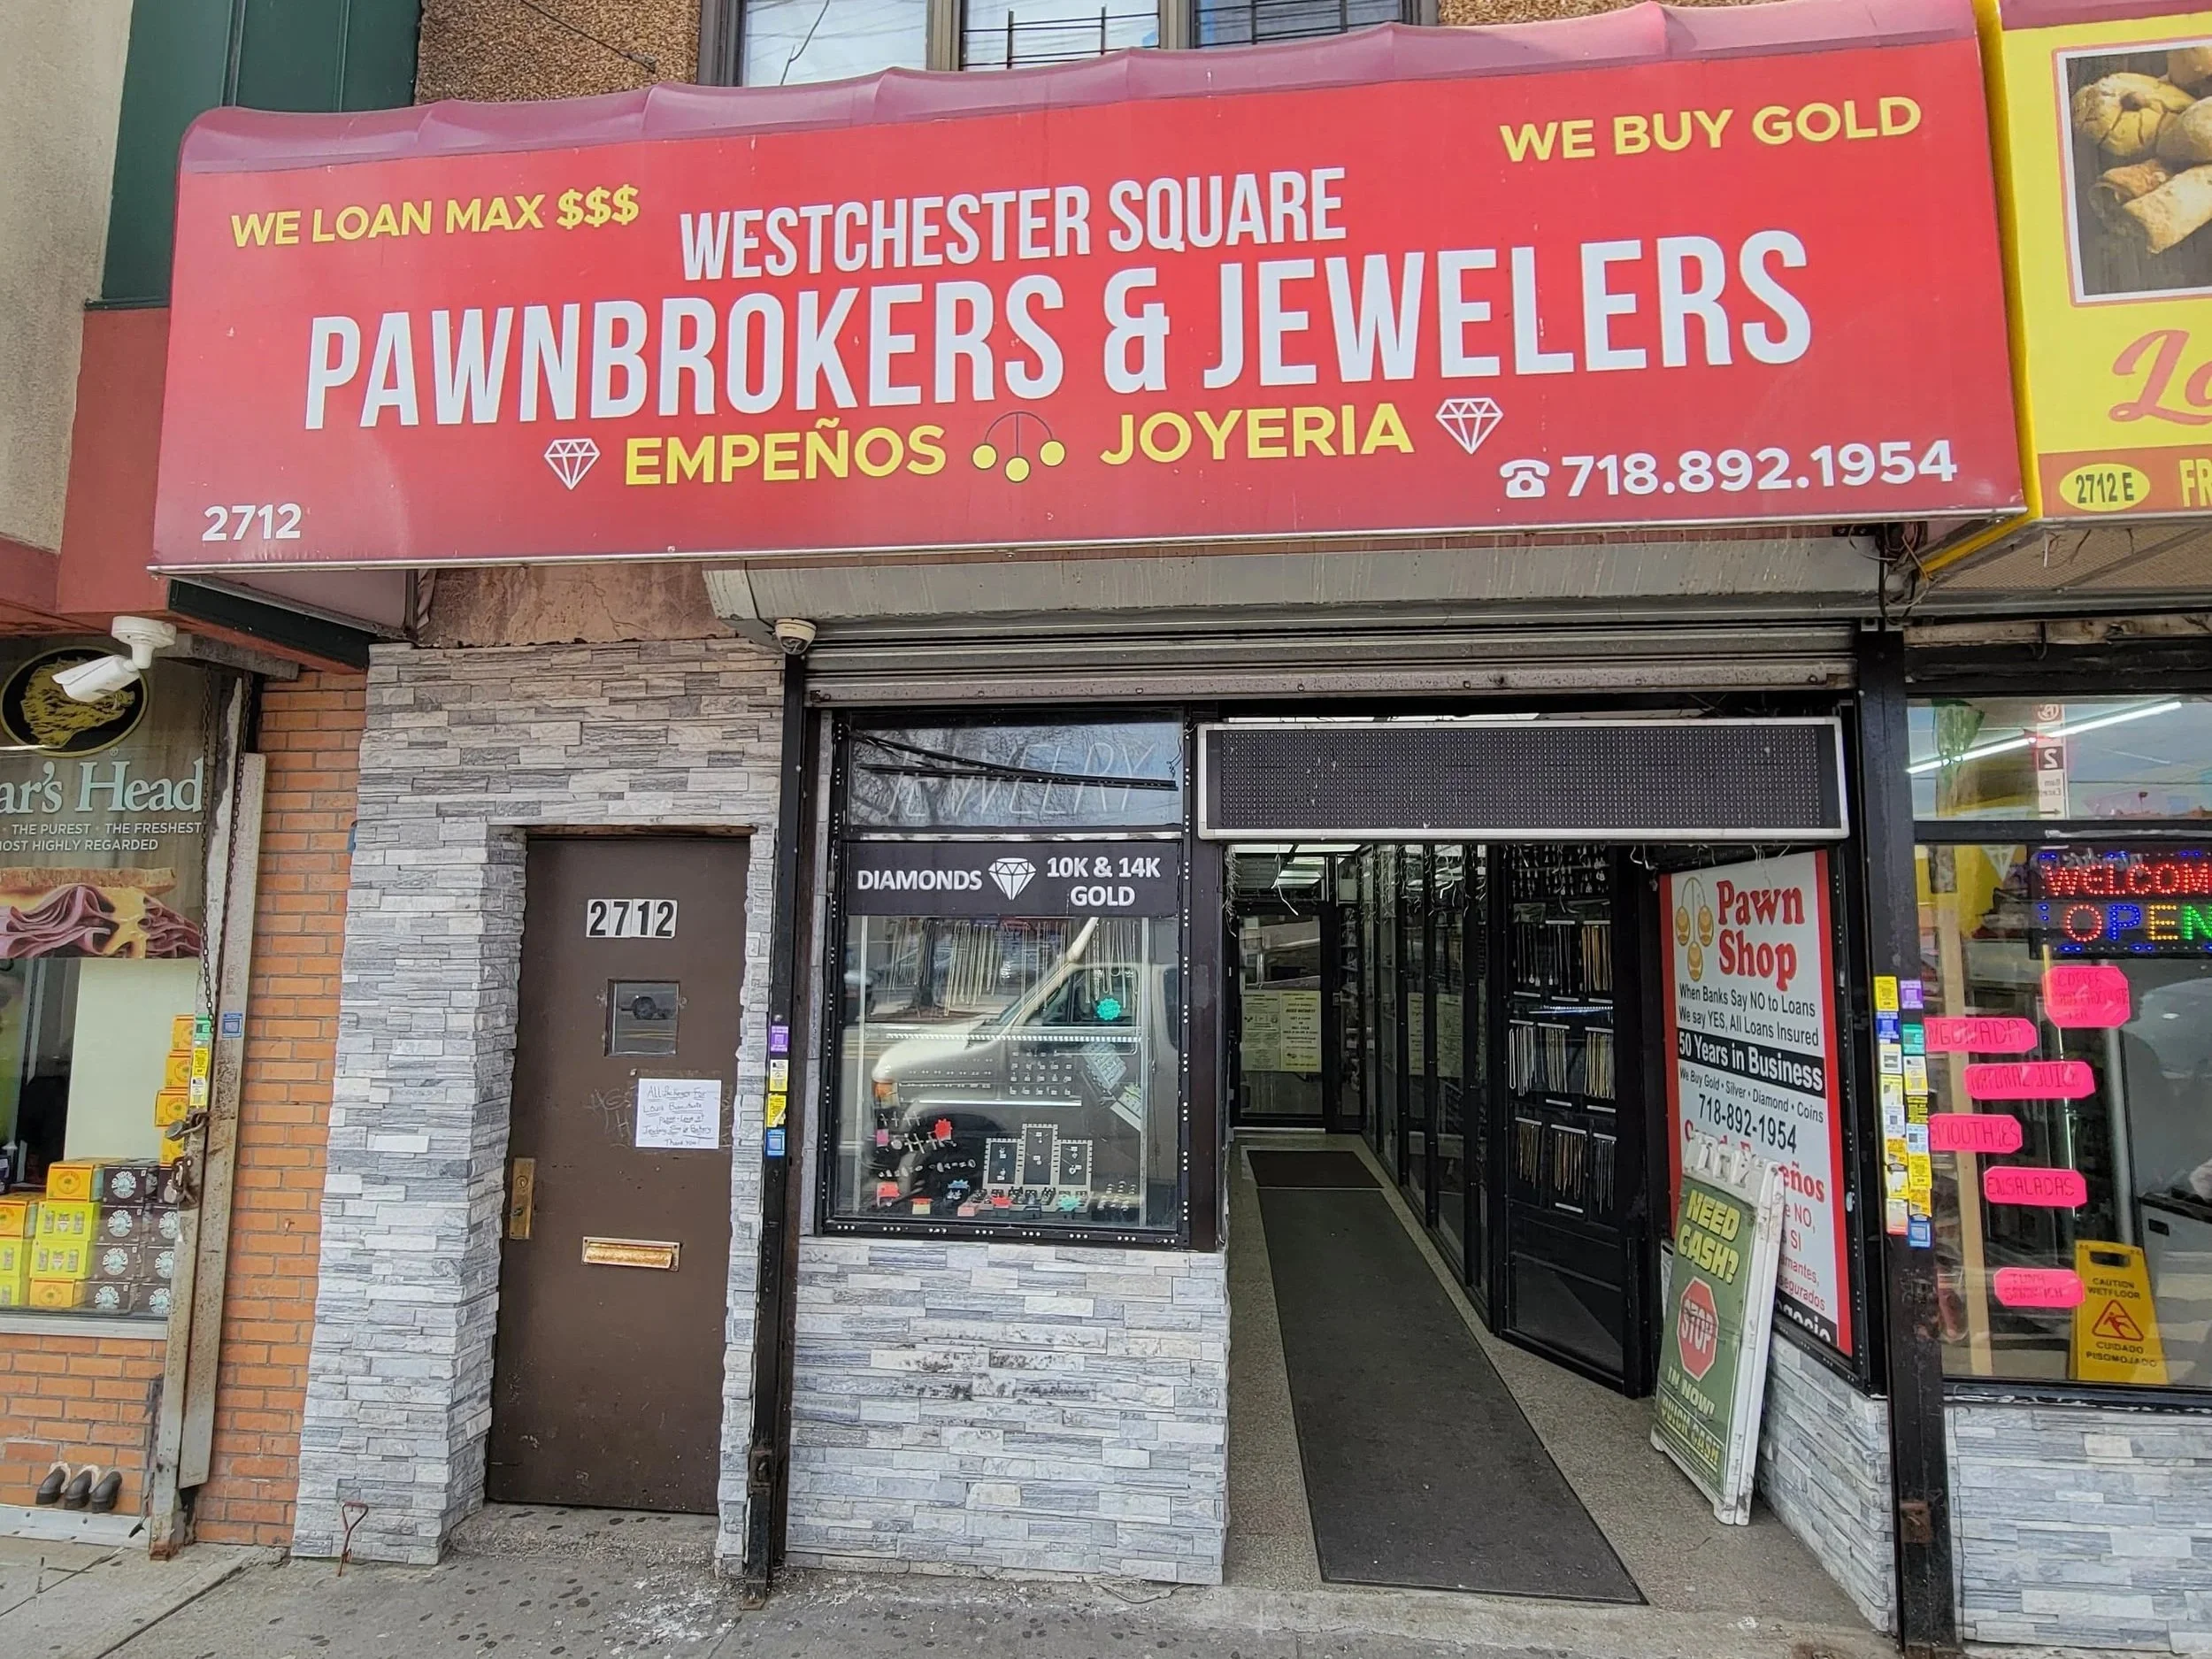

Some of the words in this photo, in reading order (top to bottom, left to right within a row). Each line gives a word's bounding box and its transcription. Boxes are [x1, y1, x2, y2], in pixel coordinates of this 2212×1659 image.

[1499, 119, 1595, 163] WE
[1614, 109, 1733, 156] BUY
[1752, 96, 1923, 145] GOLD
[231, 211, 302, 248] WE
[311, 201, 433, 243] LOAN
[445, 195, 546, 234] MAX
[556, 184, 640, 231] $$$
[680, 185, 1090, 281] WESTCHESTER
[1109, 167, 1346, 253] SQUARE
[304, 274, 1064, 430] PAWNBROKERS
[1102, 267, 1170, 394] &
[1203, 230, 1811, 388] JEWELERS
[626, 417, 947, 486] EMPEÑOS
[1100, 403, 1414, 465] JOYERIA
[1561, 440, 1958, 499] 718.892.1954
[2076, 473, 2118, 503] 2712
[2123, 472, 2134, 501] E
[202, 503, 303, 542] 2712
[75, 757, 204, 813] Head
[12, 824, 37, 835] THE
[41, 823, 91, 835] PUREST
[105, 823, 130, 834] THE
[134, 822, 202, 834] FRESHEST
[32, 839, 81, 852] HIGHLY
[84, 839, 158, 851] REGARDED
[857, 870, 983, 891] DIAMONDS
[1047, 856, 1089, 878] 10K
[1094, 856, 1113, 878] &
[1118, 856, 1161, 878] 14K
[1070, 886, 1135, 906] GOLD
[1717, 879, 1805, 926] Pawn
[589, 901, 675, 936] 2712
[2064, 903, 2212, 941] OPEN
[1719, 929, 1798, 992] Shop
[1679, 982, 1700, 1000] When
[1703, 986, 1728, 1005] Banks
[1731, 989, 1747, 1012] Say
[1750, 991, 1765, 1010] NO
[1769, 995, 1778, 1011] to
[1781, 995, 1816, 1018] Loans
[1679, 1005, 1691, 1022] We
[1693, 1012, 1706, 1029] say
[1708, 1010, 1728, 1033] YES,
[1730, 1014, 1742, 1033] All
[1744, 1017, 1774, 1039] Loans
[1777, 1022, 1819, 1047] Insured
[1679, 1032, 1692, 1056] 50
[1694, 1033, 1728, 1067] Years
[1732, 1042, 1745, 1071] in
[1748, 1046, 1824, 1091] Business
[1680, 1065, 1689, 1081] We
[1690, 1070, 1702, 1088] Buy
[1704, 1074, 1720, 1091] Gold
[1725, 1080, 1746, 1098] Silver
[1753, 1088, 1789, 1112] Diamond
[1797, 1101, 1824, 1124] Coins
[1699, 1094, 1797, 1154] 718-892-1954
[1986, 1177, 2075, 1196] ENSALADAS
[1686, 1189, 1740, 1241] NEED
[1678, 1224, 1740, 1284] CASH?
[2092, 1278, 2134, 1288] CAUTION
[1681, 1299, 1714, 1354] STOP
[2096, 1341, 2144, 1354] CUIDADO
[1667, 1365, 1680, 1388] IN
